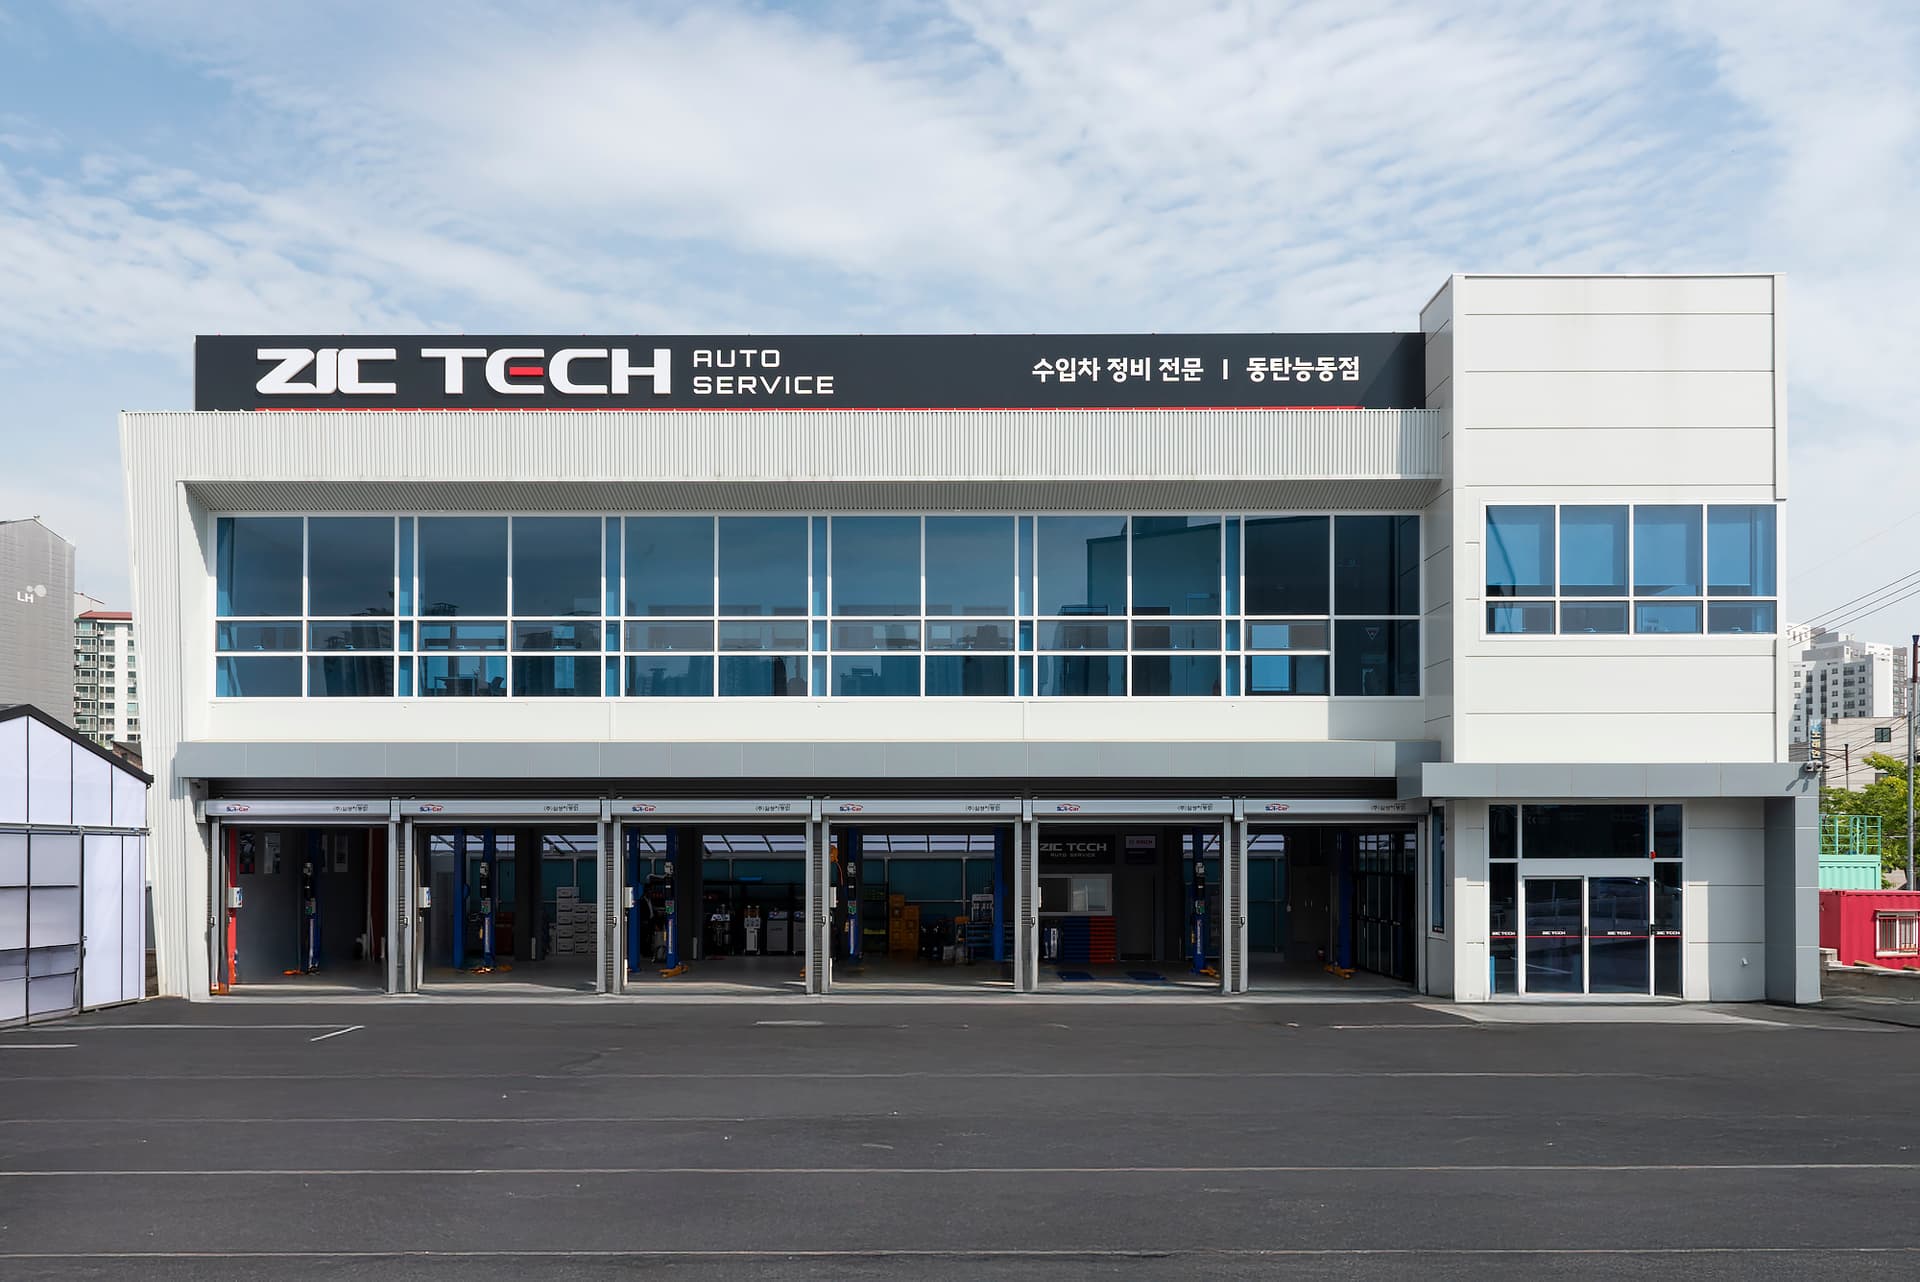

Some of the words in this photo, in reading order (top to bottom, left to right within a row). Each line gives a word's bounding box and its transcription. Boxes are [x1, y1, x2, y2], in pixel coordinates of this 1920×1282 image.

[693, 349, 781, 368] AUTO
[1031, 357, 1101, 383] 수입차
[1106, 357, 1151, 383] 정비
[1158, 356, 1204, 382] 전문
[1246, 356, 1360, 382] 동탄능동점
[256, 349, 397, 394] ZIC
[421, 348, 671, 394] TECH
[693, 375, 834, 395] SERVICE
[17, 591, 34, 603] LH
